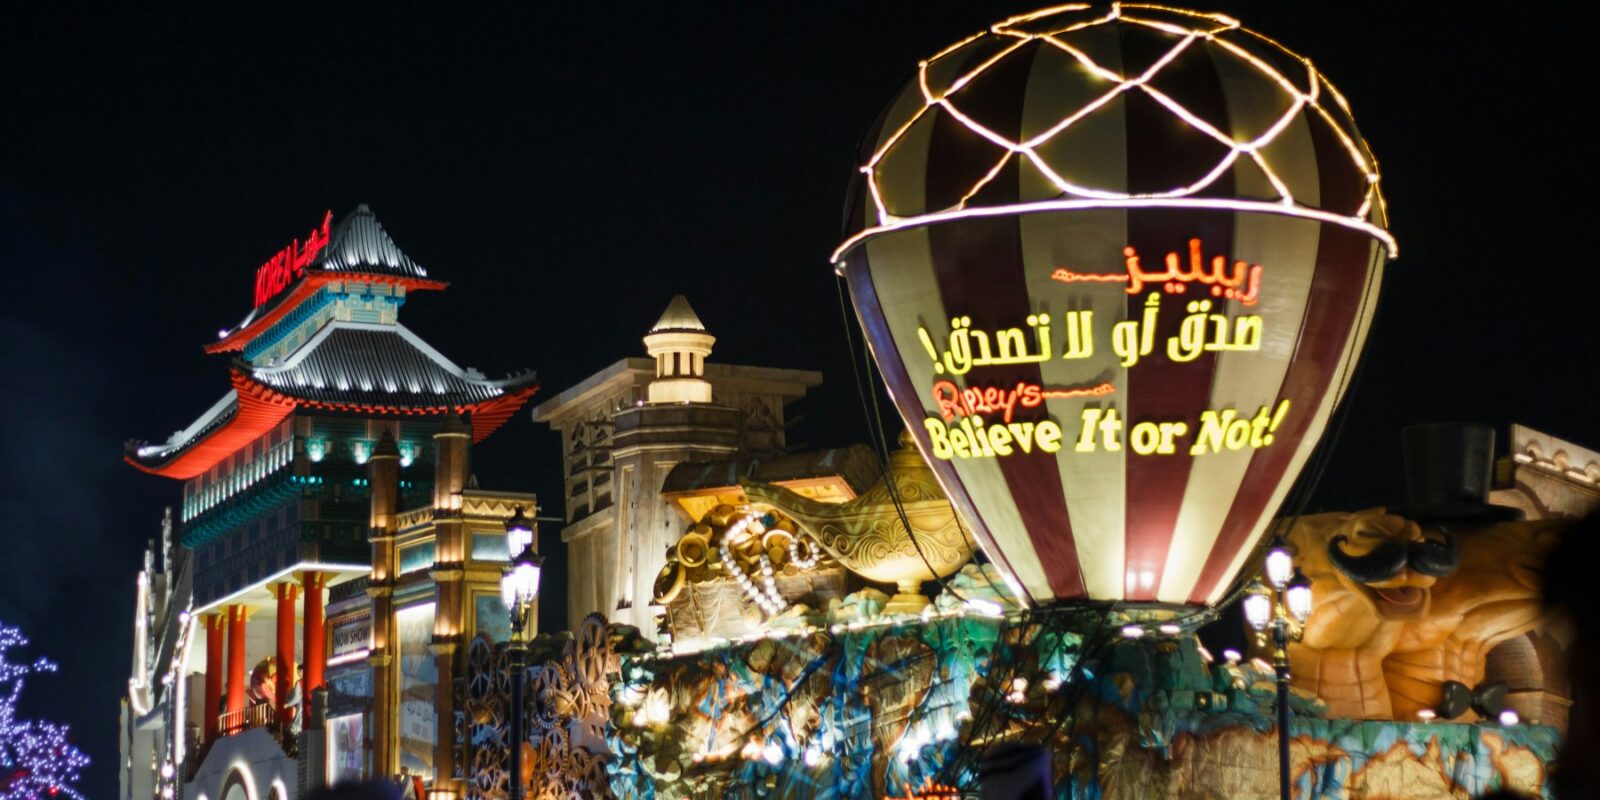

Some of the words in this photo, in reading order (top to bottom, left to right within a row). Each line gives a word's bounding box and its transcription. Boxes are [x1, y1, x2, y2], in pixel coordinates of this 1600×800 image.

[293, 208, 333, 278] كوريا
[1123, 238, 1263, 305] ريبليز
[255, 245, 292, 309] KOREA
[1062, 310, 1094, 360] لا
[1111, 292, 1160, 367] أو
[1167, 300, 1263, 361] صدق
[925, 416, 1062, 460] Believe
[1075, 408, 1122, 452] It
[1130, 420, 1187, 455] or
[1190, 399, 1290, 456] Not!
